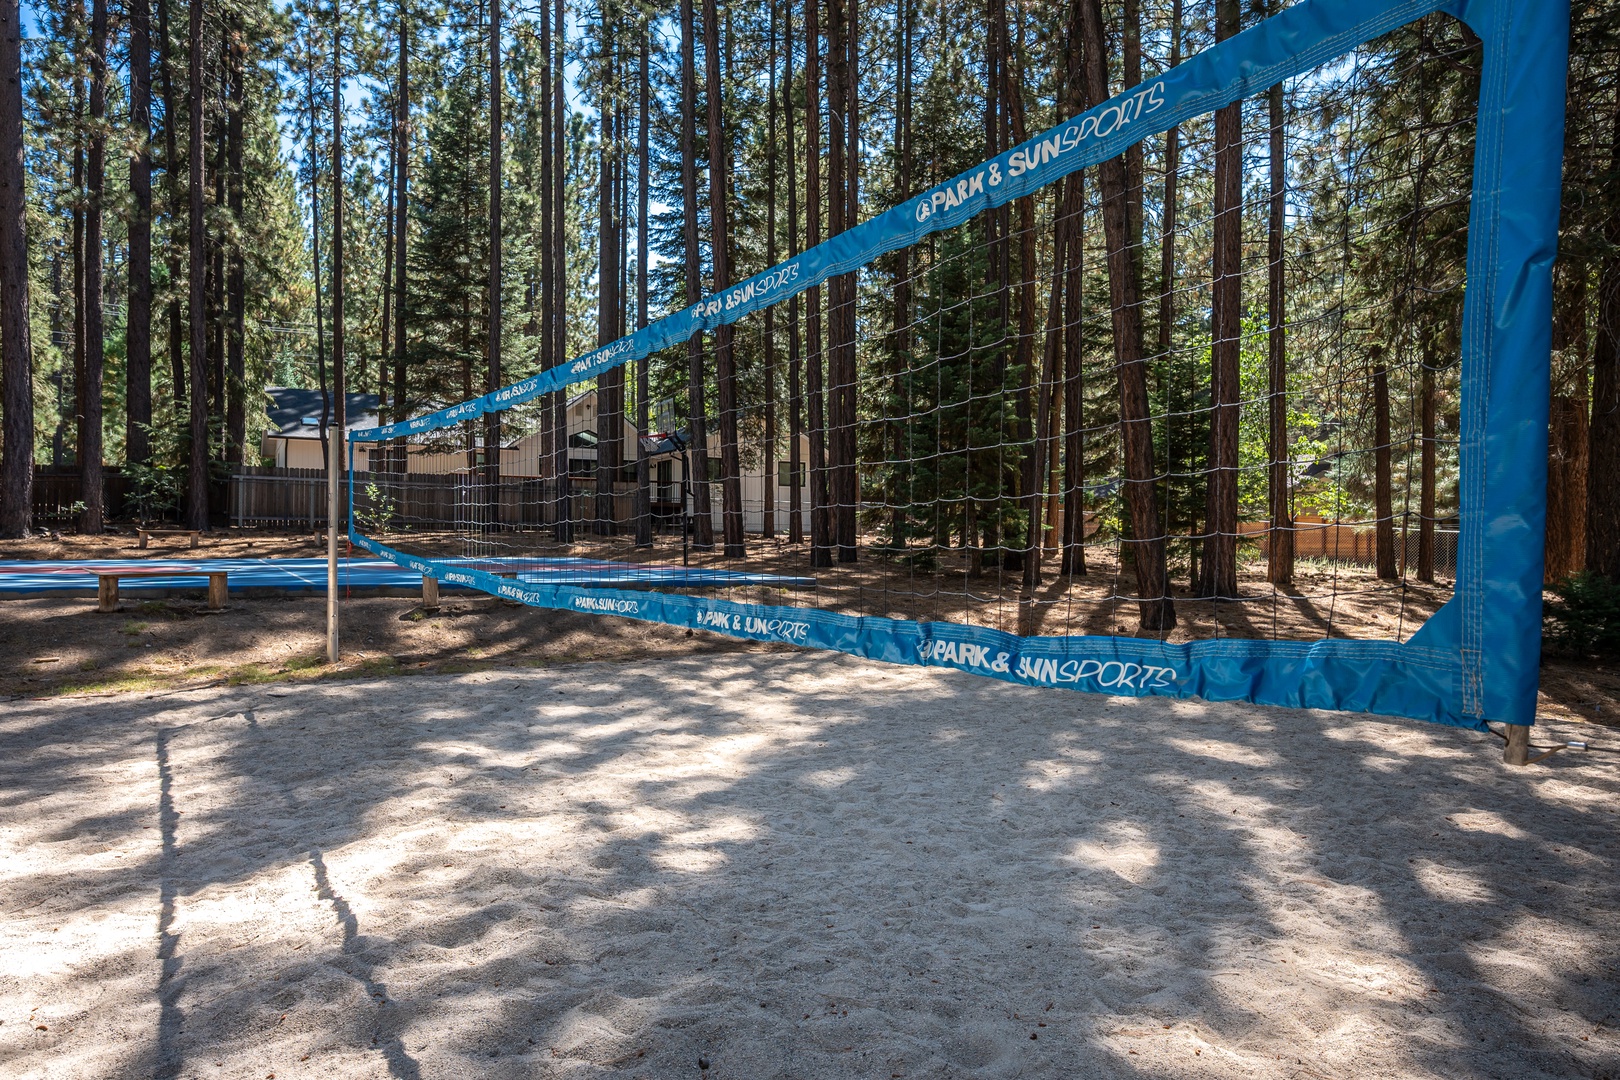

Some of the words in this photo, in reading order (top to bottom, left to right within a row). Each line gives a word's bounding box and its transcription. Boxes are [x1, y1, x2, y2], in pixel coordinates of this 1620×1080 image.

[931, 170, 985, 213] PARK
[988, 162, 1002, 187] &
[725, 294, 734, 310] &
[732, 614, 741, 631] &
[933, 639, 990, 668] PARK
[991, 651, 1010, 673] &
